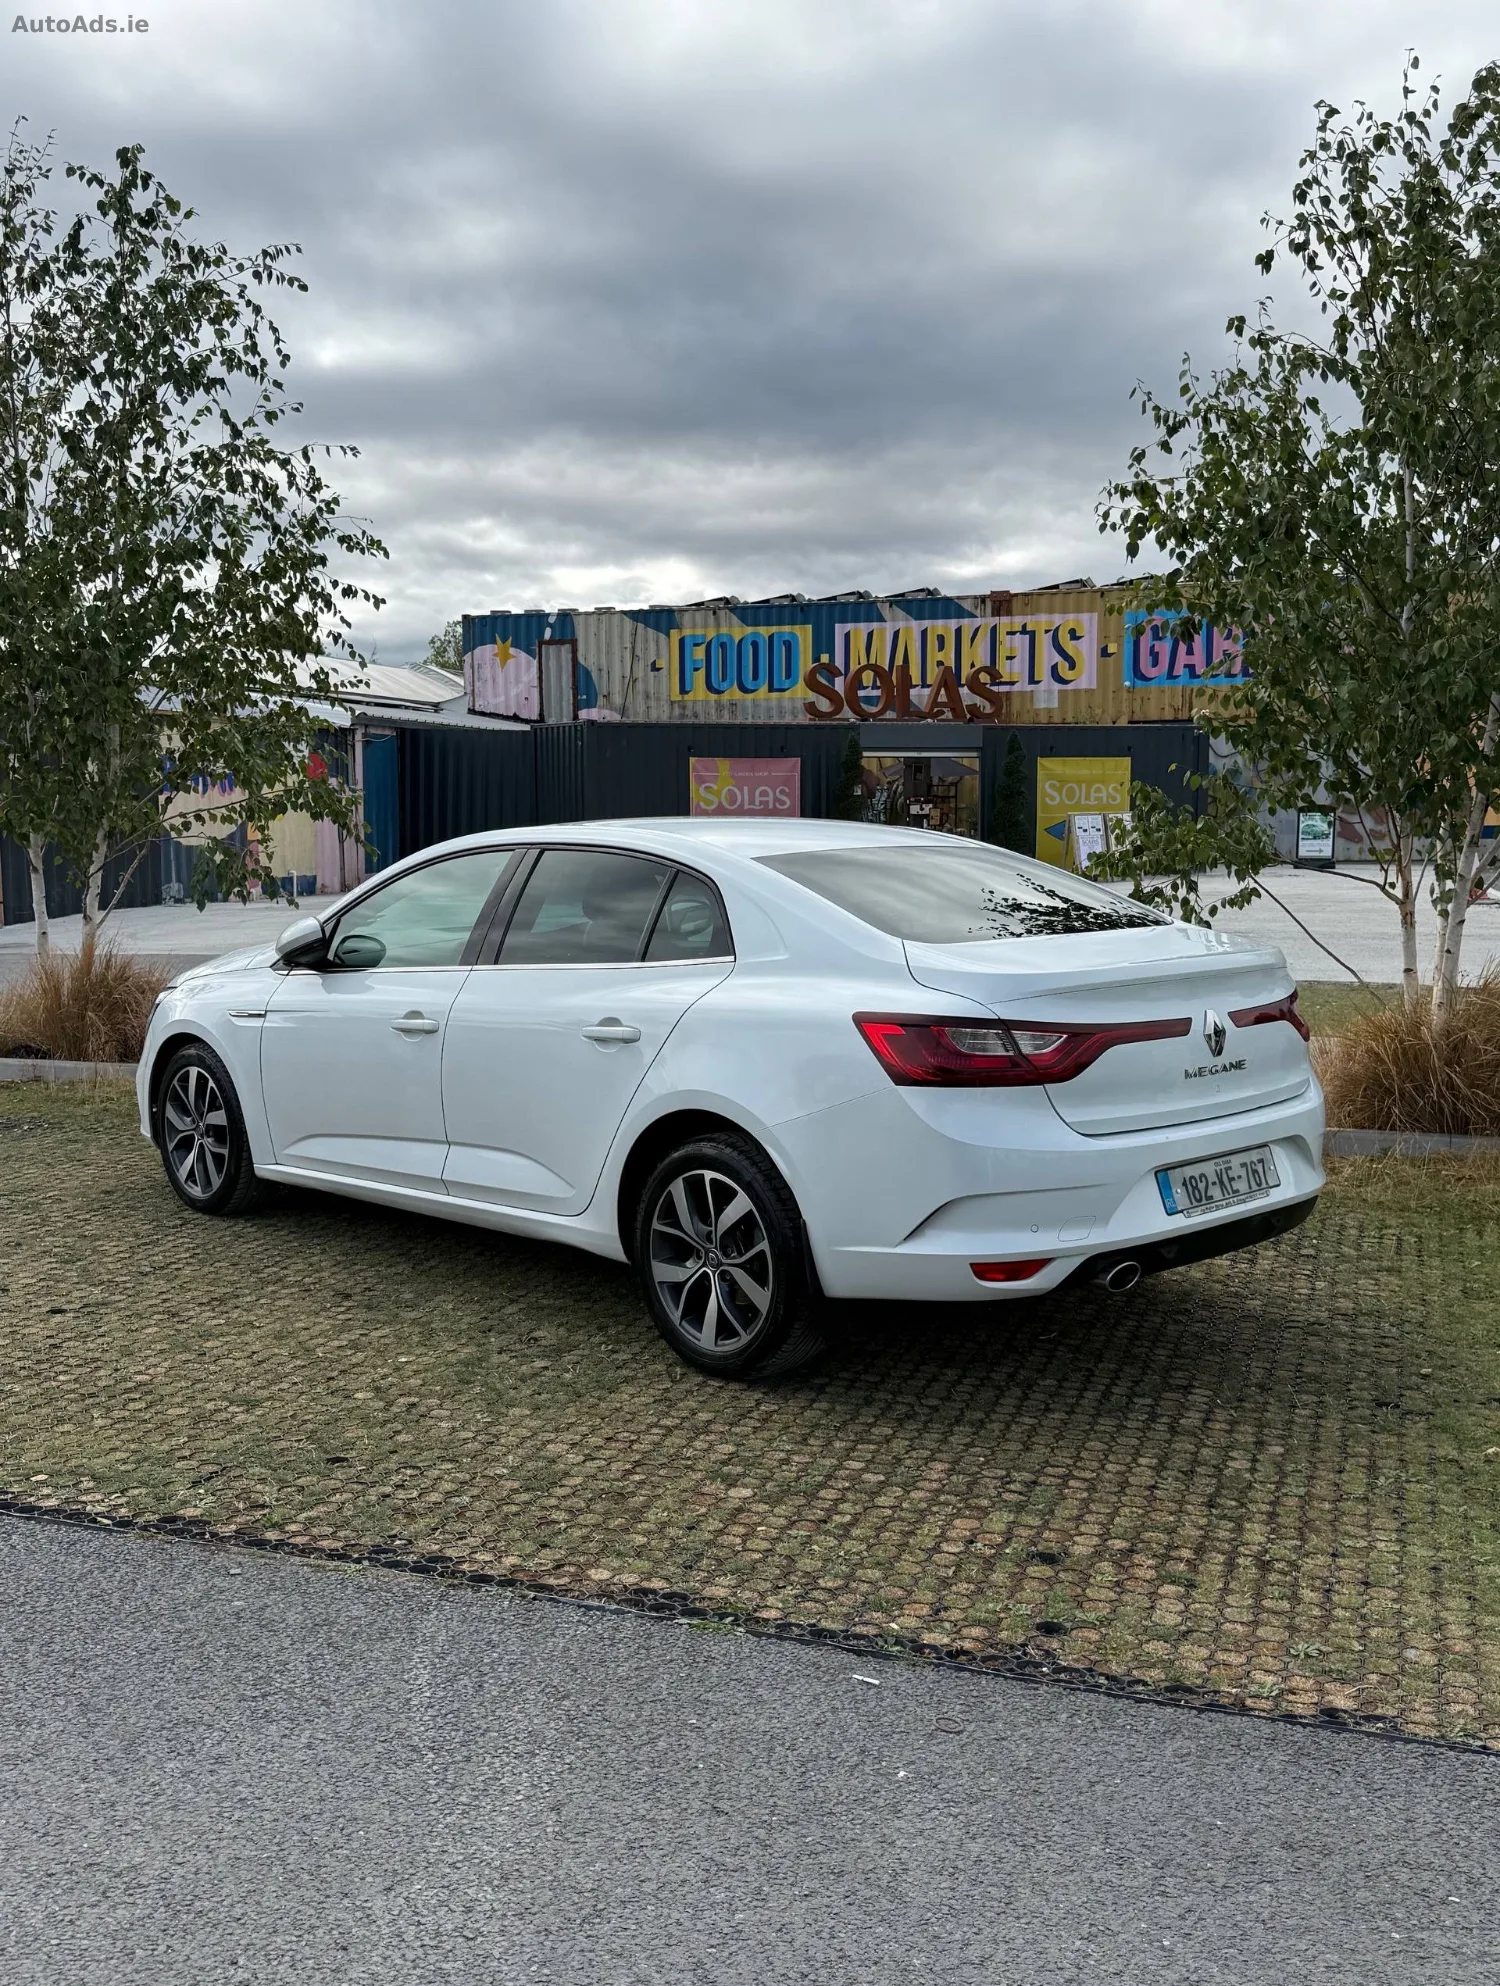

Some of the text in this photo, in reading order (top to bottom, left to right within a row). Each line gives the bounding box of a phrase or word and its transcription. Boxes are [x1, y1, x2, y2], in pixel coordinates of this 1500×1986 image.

[679, 615, 1255, 695] FOOD MARKETS GAR
[803, 662, 1004, 719] SOLAS
[699, 783, 791, 810] SOLAS
[1045, 780, 1122, 805] SOLAS
[1184, 1059, 1247, 1080] MEGANE
[1182, 1158, 1270, 1206] 182-KE-767
